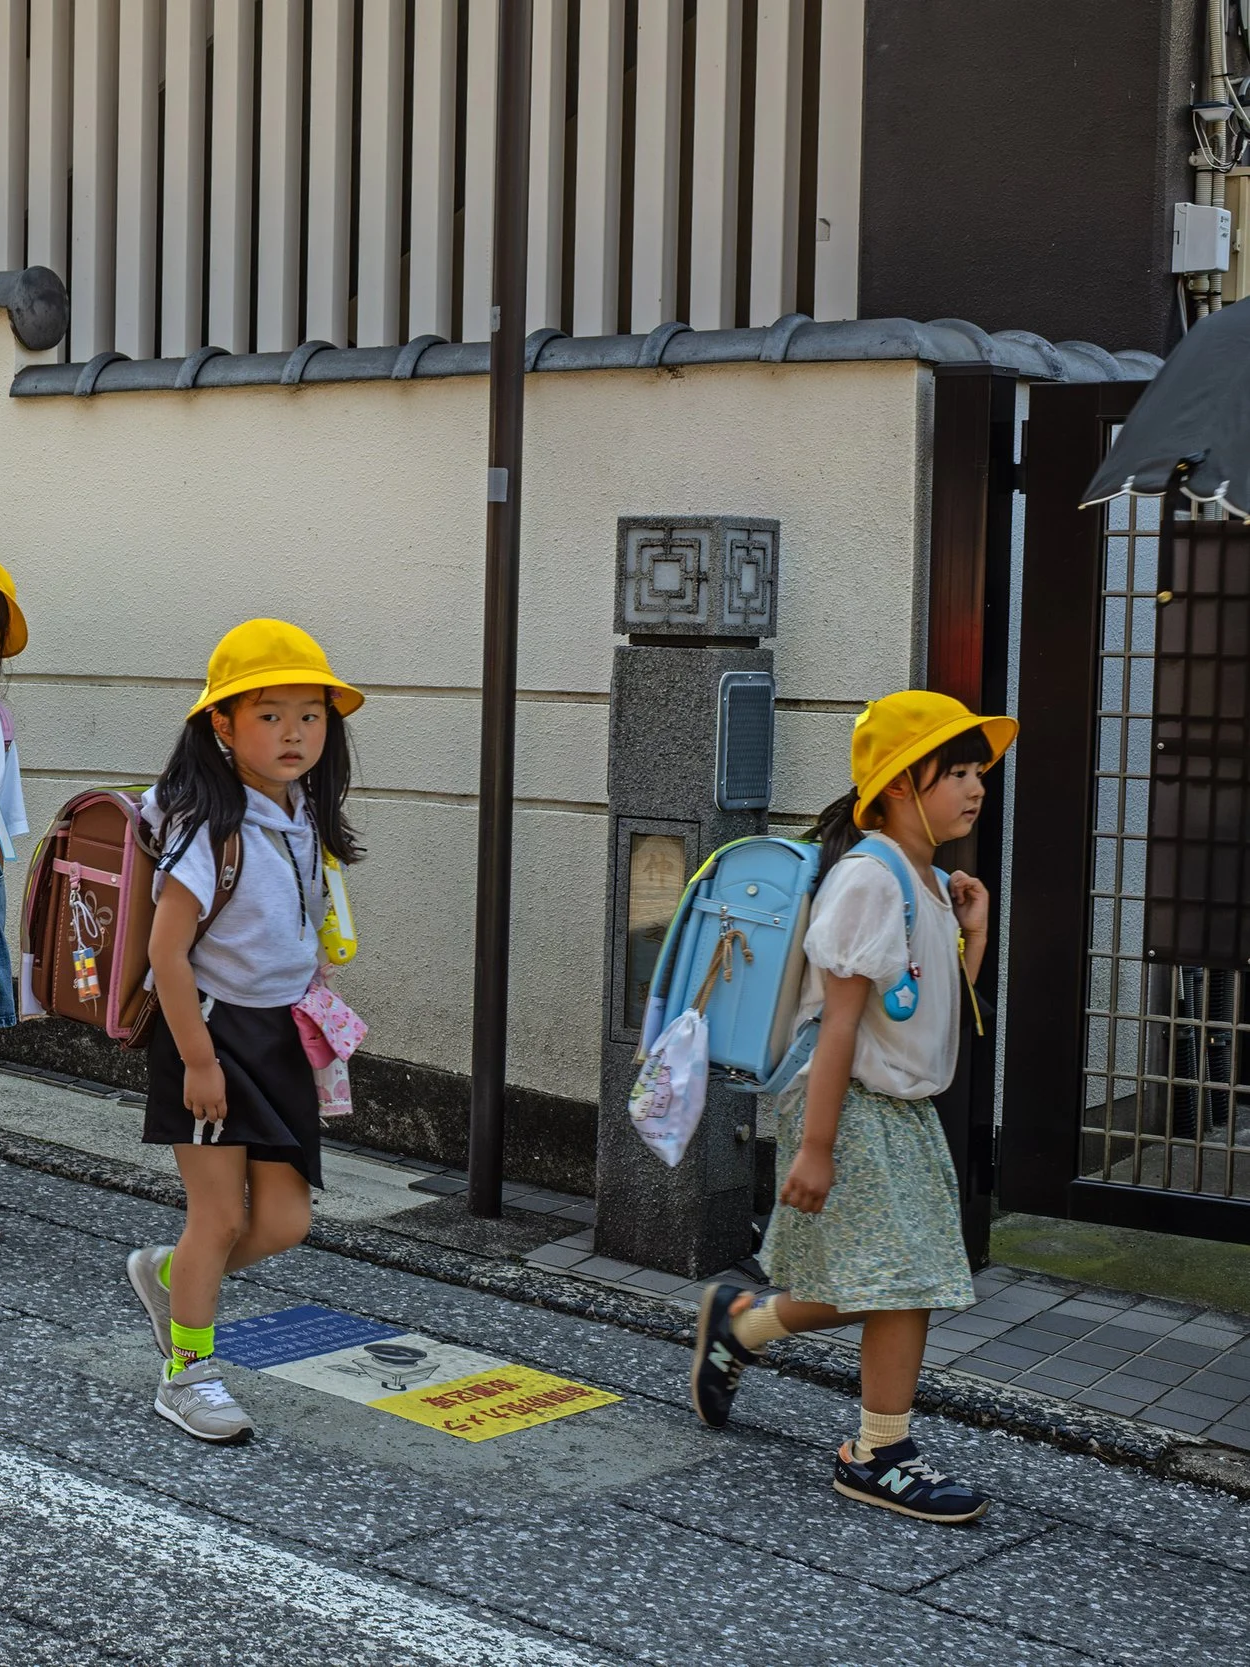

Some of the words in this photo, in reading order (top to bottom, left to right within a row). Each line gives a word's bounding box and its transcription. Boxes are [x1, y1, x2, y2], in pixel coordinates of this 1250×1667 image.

[172, 1387, 201, 1416] N
[420, 1379, 521, 1410] 設置区域
[443, 1385, 594, 1432] 街頭防犯カメラ
[877, 1467, 915, 1495] N
